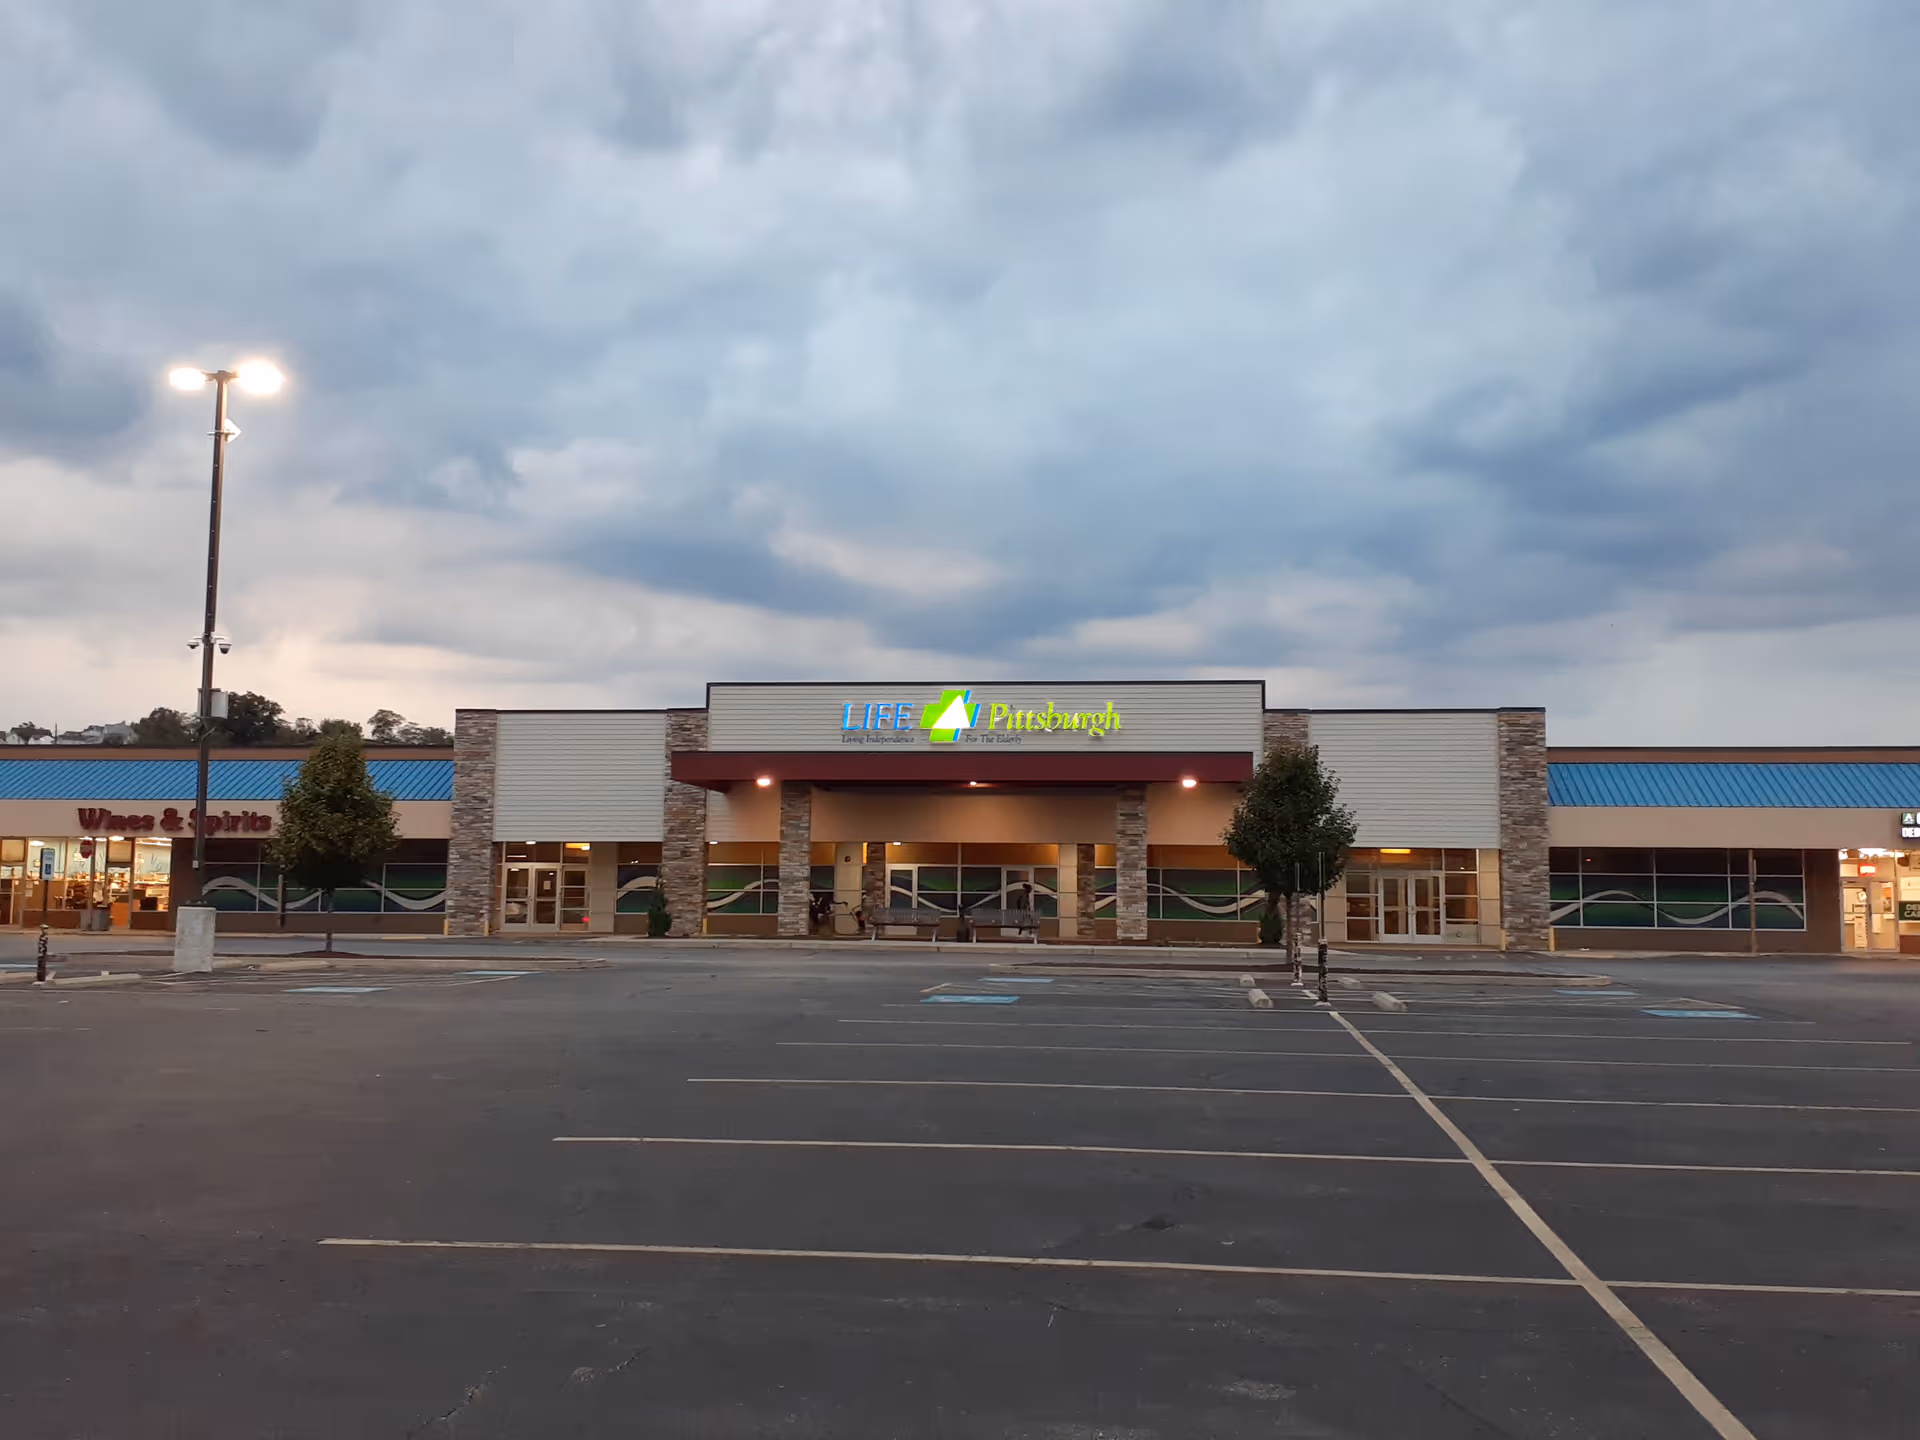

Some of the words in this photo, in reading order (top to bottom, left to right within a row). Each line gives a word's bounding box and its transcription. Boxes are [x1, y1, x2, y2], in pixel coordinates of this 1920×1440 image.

[842, 703, 913, 730] LIFE
[988, 702, 1121, 737] Pittsburgh
[842, 735, 864, 743] Living
[866, 735, 914, 743] Independence
[966, 735, 978, 743] For
[980, 735, 995, 743] The
[997, 735, 1023, 744] Elderly
[78, 808, 155, 831] Wines
[160, 808, 184, 831] &
